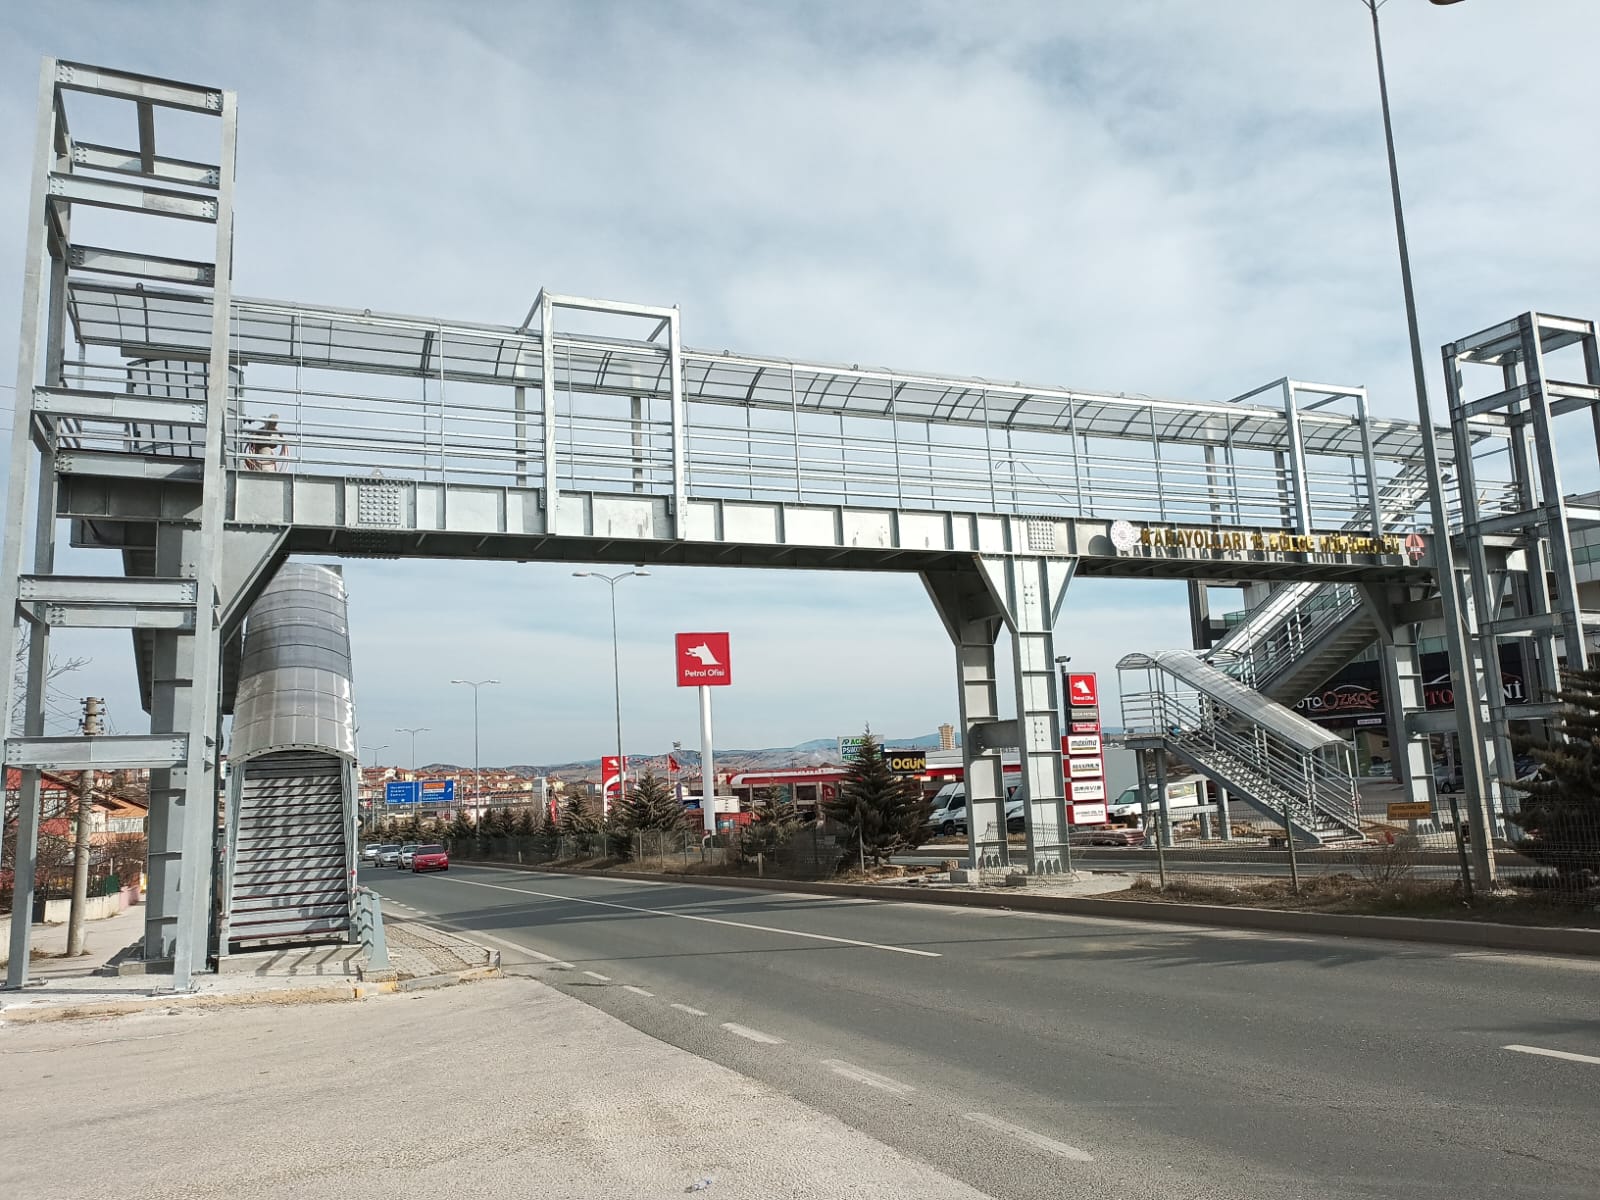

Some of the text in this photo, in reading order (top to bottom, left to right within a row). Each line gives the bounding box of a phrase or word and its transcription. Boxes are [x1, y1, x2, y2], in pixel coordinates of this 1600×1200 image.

[1140, 527, 1247, 550] KARAYOLLARI
[685, 668, 725, 677] Petrol Ofisi
[1425, 688, 1454, 706] TO
